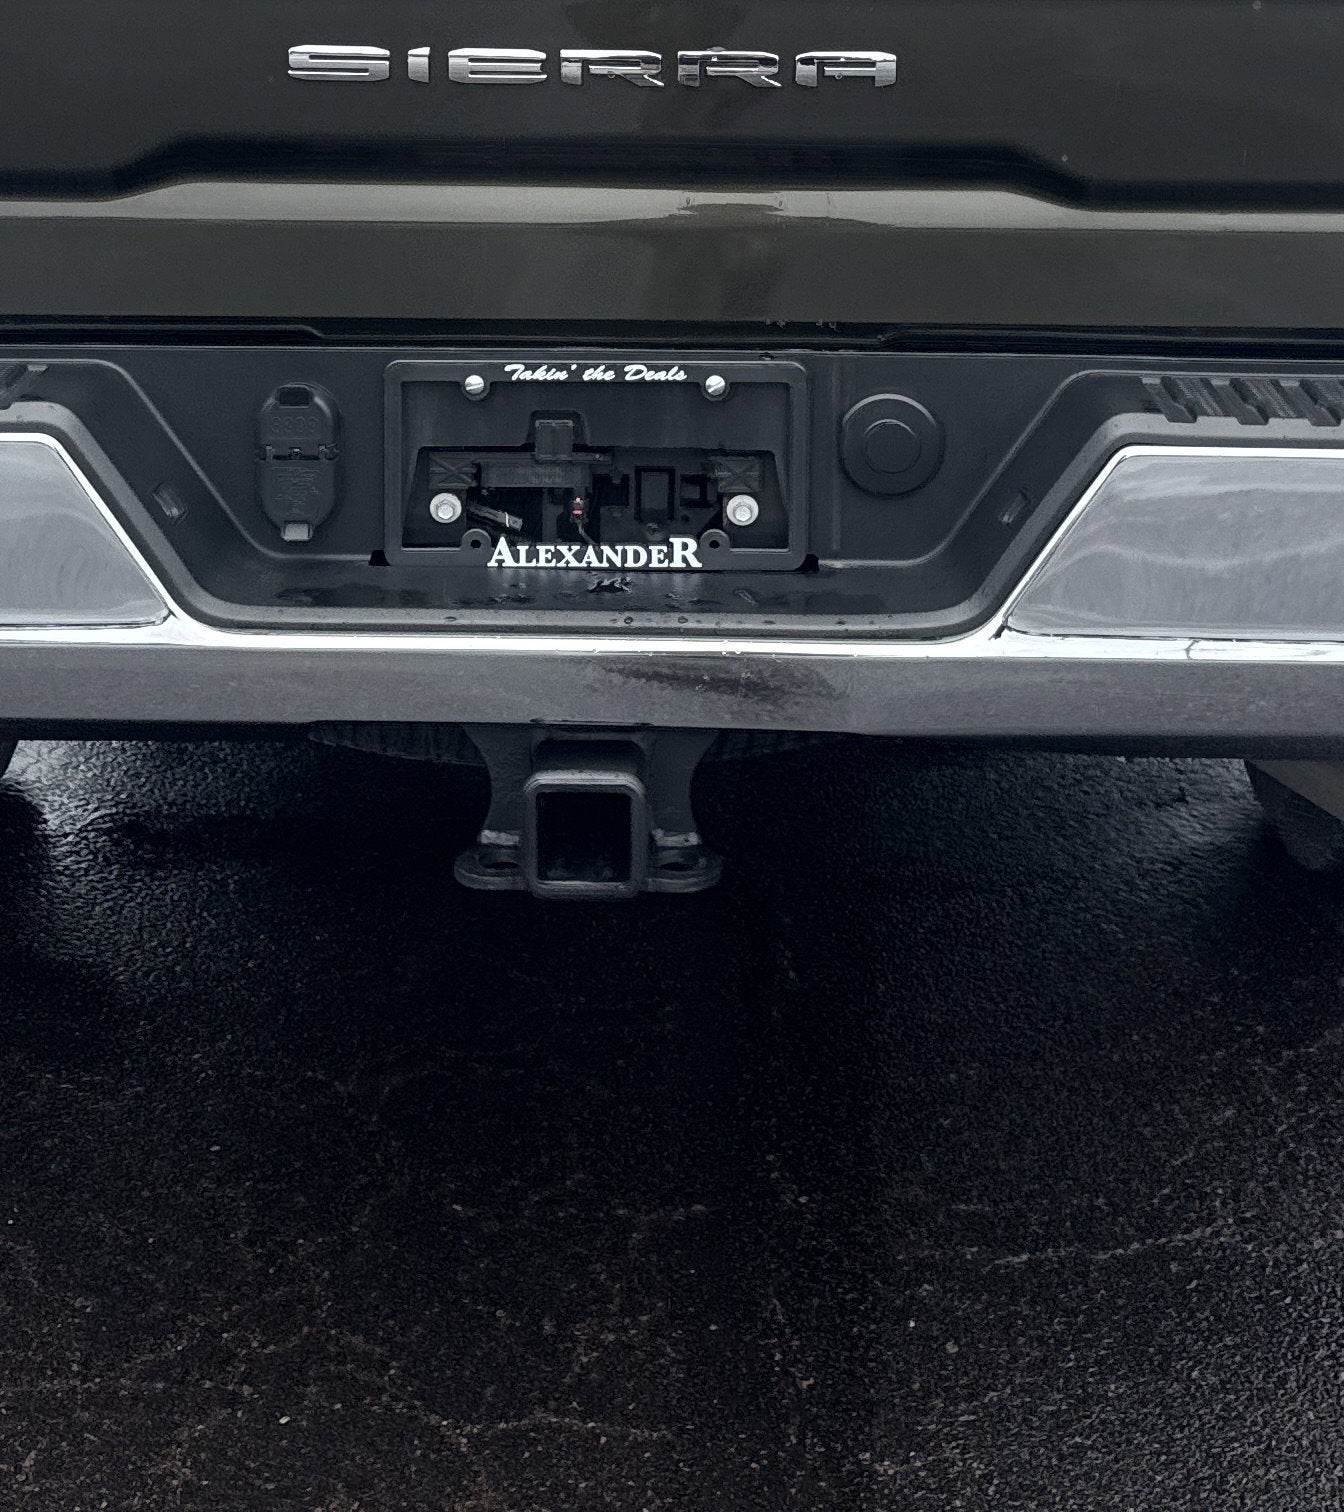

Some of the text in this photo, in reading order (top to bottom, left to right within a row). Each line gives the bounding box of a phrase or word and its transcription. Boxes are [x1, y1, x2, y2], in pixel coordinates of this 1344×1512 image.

[287, 45, 898, 88] SIERRA
[504, 363, 688, 381] Takin' the Deals
